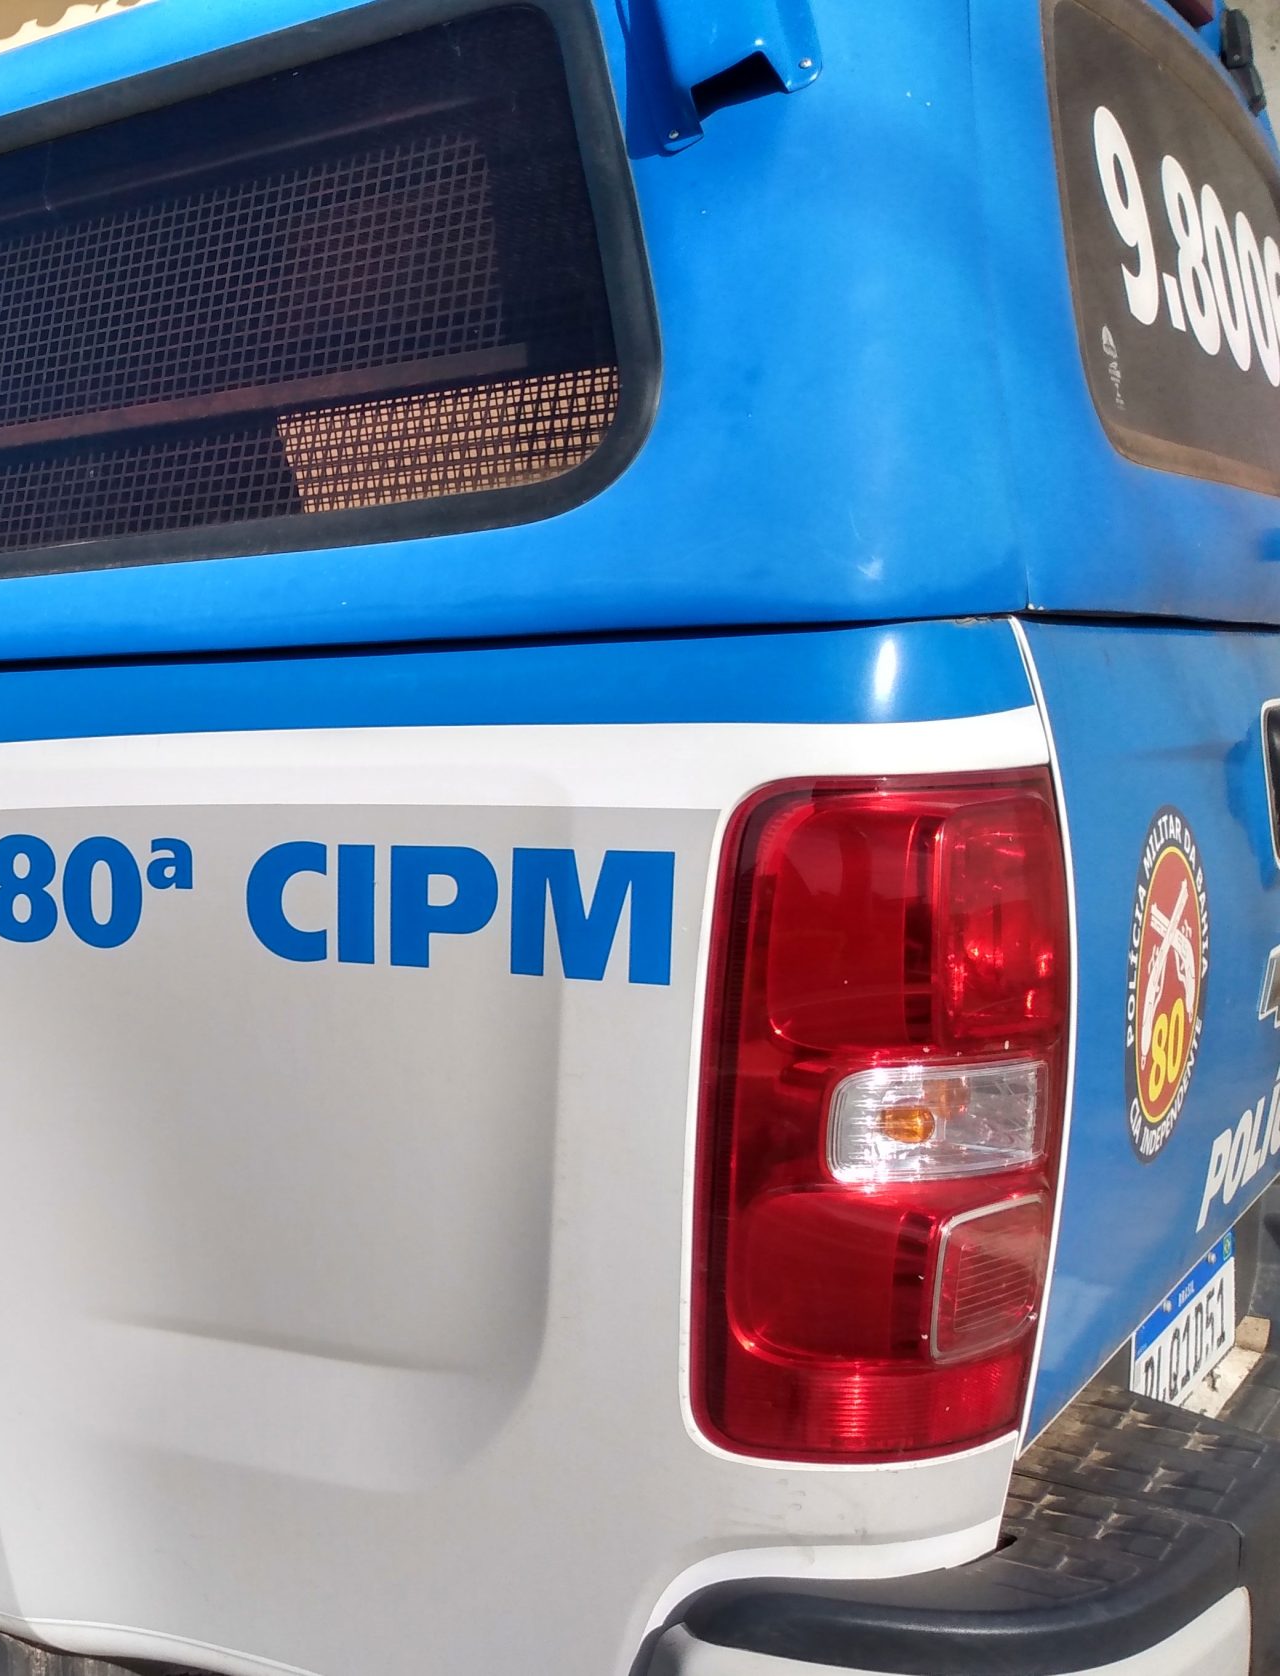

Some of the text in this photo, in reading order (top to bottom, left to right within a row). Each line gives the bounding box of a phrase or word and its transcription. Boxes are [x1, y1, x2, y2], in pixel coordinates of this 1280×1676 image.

[1093, 105, 1280, 388] 9.800
[246, 840, 676, 986] CIPM
[1143, 814, 1182, 880] MILITAR
[1183, 827, 1197, 871] DA
[1196, 865, 1209, 979] BAHIA
[1129, 1017, 1203, 1157] CIA INDEPENDENTE
[1148, 997, 1185, 1103] 80
[1178, 1280, 1195, 1307] BRASIL
